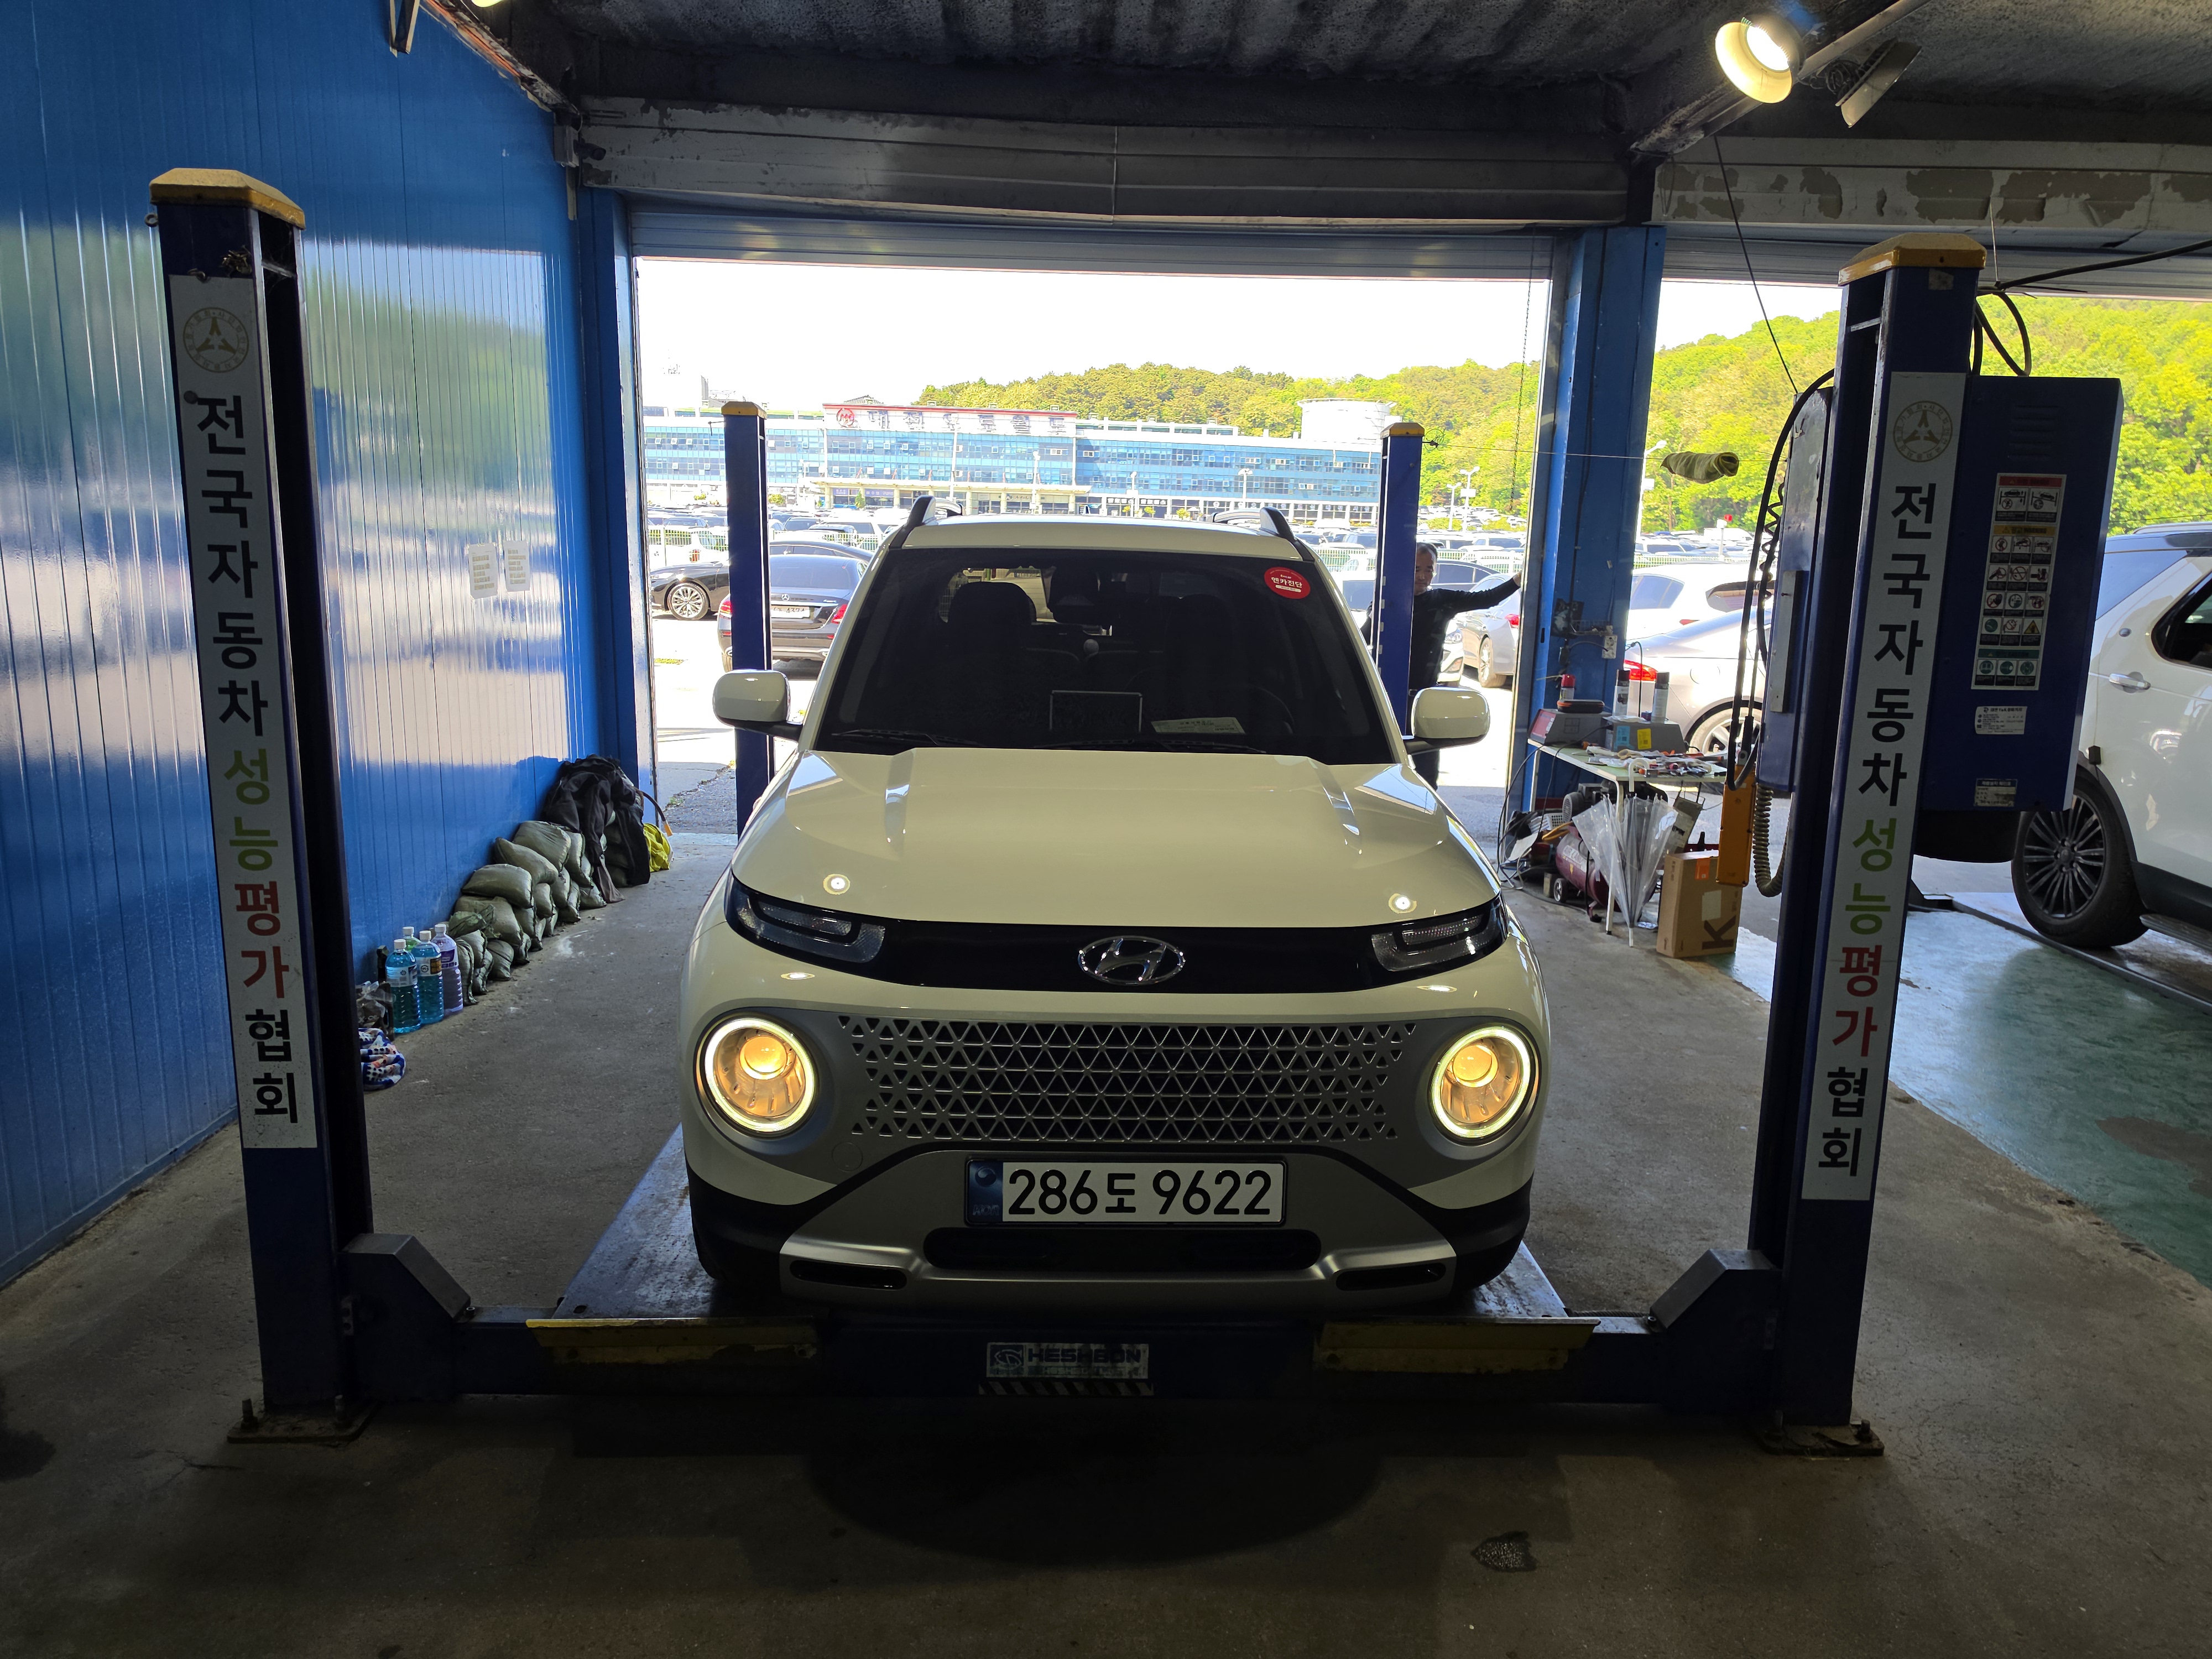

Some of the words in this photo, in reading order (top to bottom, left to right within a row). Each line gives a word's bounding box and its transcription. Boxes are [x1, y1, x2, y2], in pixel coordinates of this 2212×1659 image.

[1271, 577, 1303, 588] 엔카진단
[196, 394, 298, 1124] 전국자동차성능평가협회
[1818, 483, 1937, 1177] 전국자동차성능평가협회
[1702, 915, 1737, 950] K
[972, 1204, 1000, 1215] KOR
[1008, 1168, 1136, 1215] 286도
[1152, 1170, 1271, 1215] 9622
